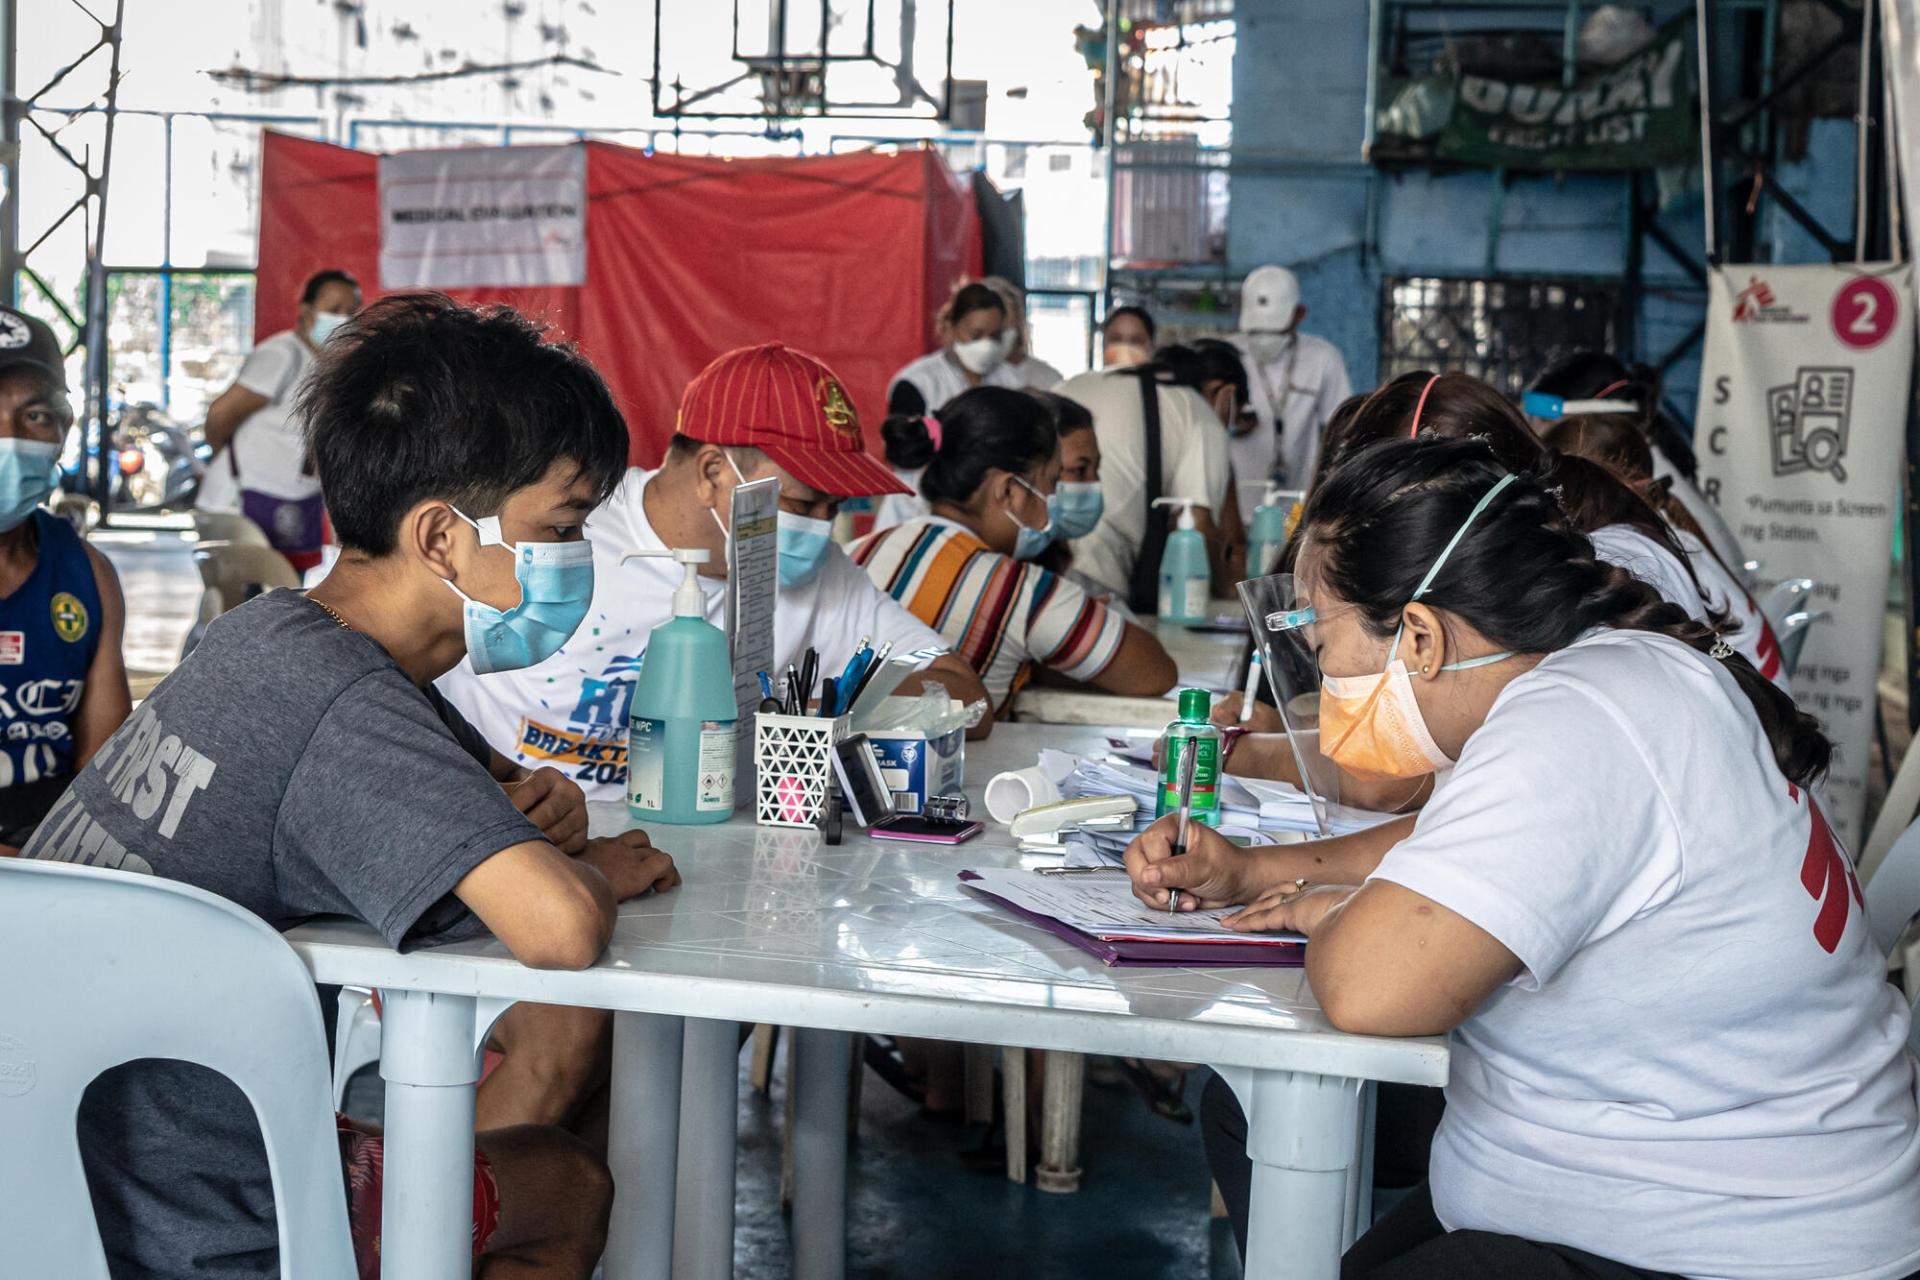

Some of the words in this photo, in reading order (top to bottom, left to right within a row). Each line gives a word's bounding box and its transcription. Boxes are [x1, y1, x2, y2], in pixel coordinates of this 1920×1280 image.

[1849, 291, 1878, 333] 2
[523, 725, 628, 761] BREAKT
[105, 703, 217, 840] FIRST
